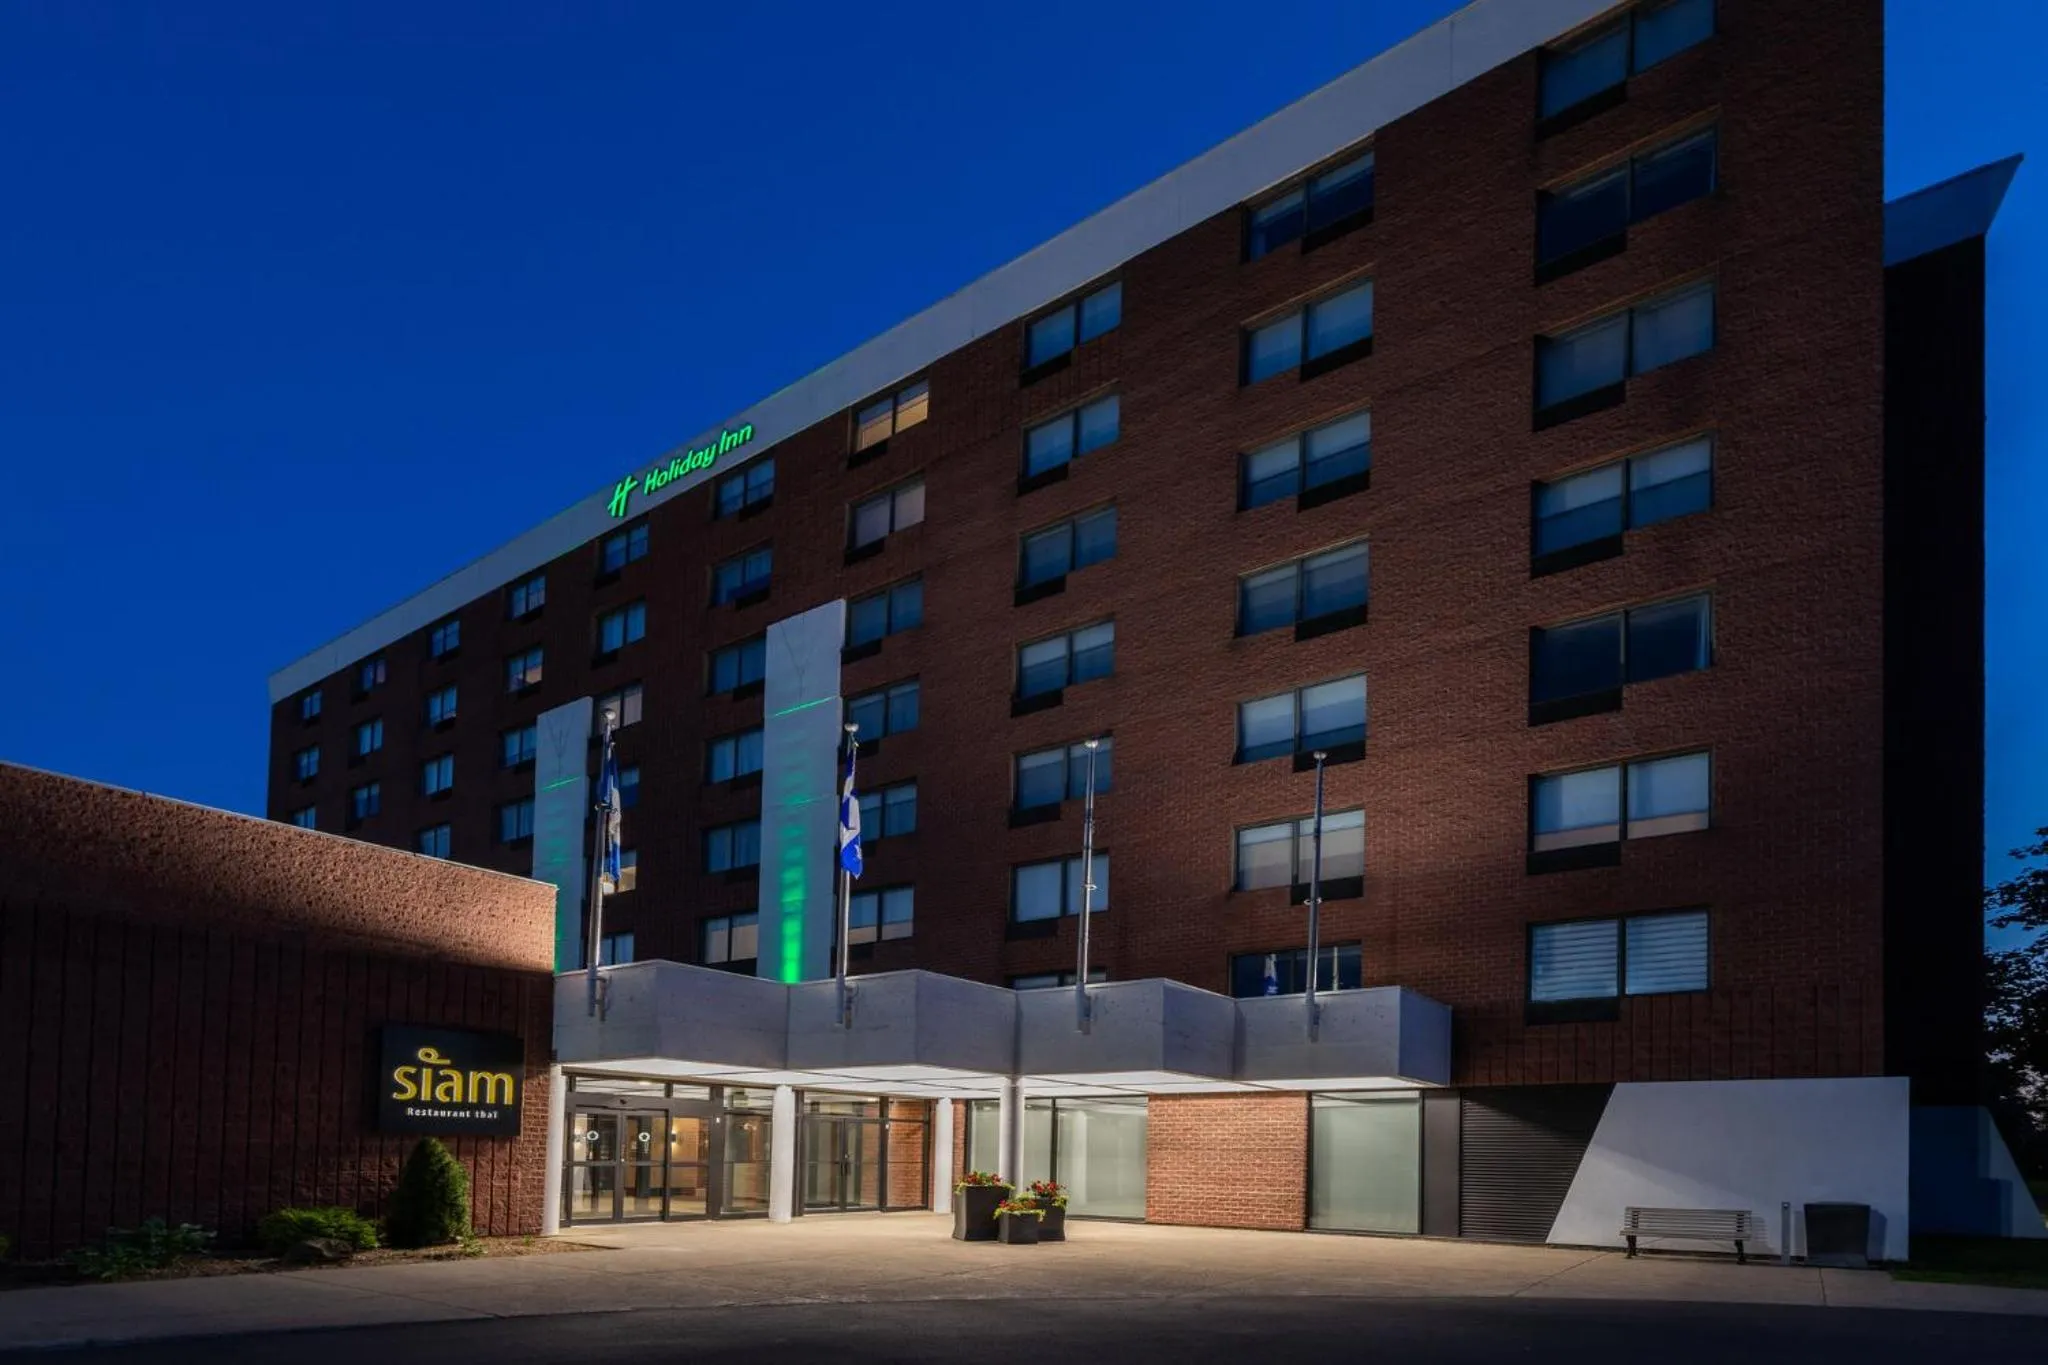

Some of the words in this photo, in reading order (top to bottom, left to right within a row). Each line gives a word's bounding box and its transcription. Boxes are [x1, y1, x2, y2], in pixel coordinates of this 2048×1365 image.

[643, 443, 717, 495] Holiday
[718, 424, 753, 455] Inn
[392, 1047, 514, 1105] siam
[406, 1107, 471, 1118] Restaurant
